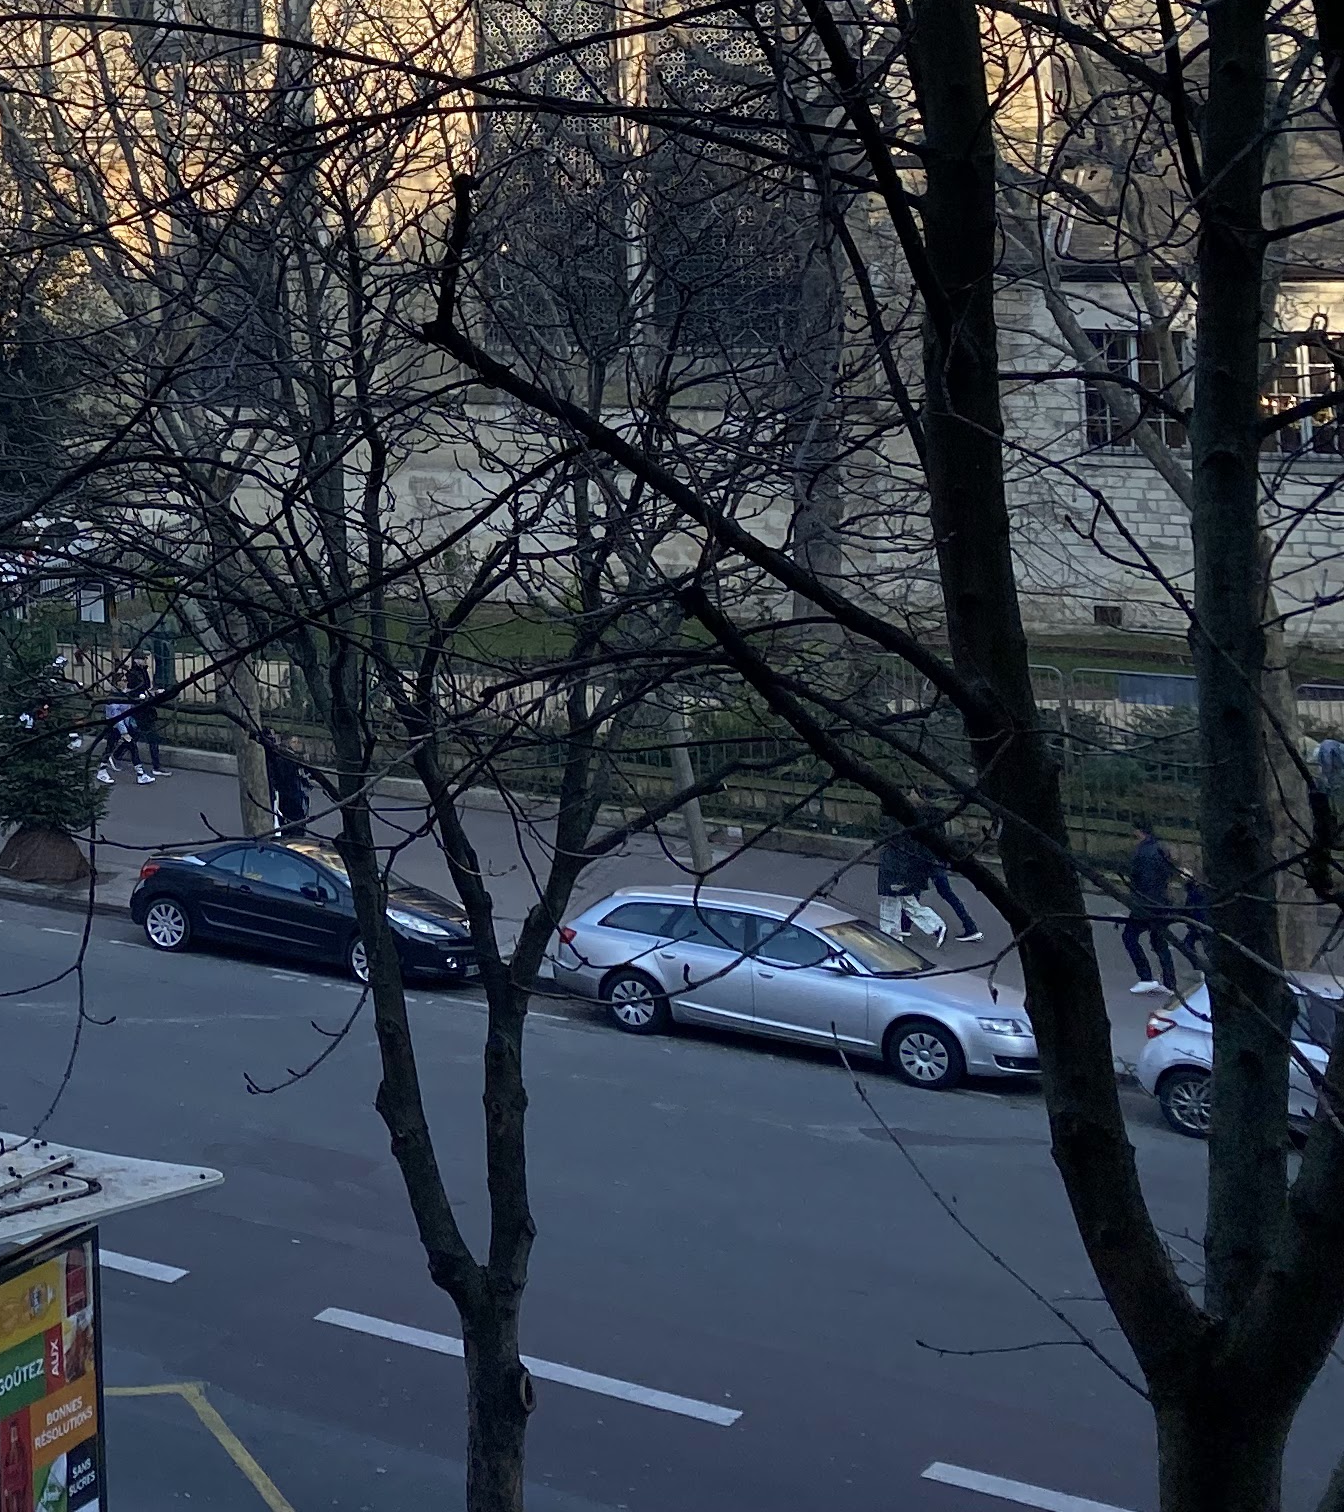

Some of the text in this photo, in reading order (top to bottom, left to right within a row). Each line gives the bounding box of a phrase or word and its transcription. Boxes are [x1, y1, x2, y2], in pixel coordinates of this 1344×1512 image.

[51, 1338, 60, 1376] AUX
[34, 1405, 93, 1450] RÉSOLUTIONS
[46, 1395, 83, 1426] BONNES
[72, 1457, 92, 1479] SANS
